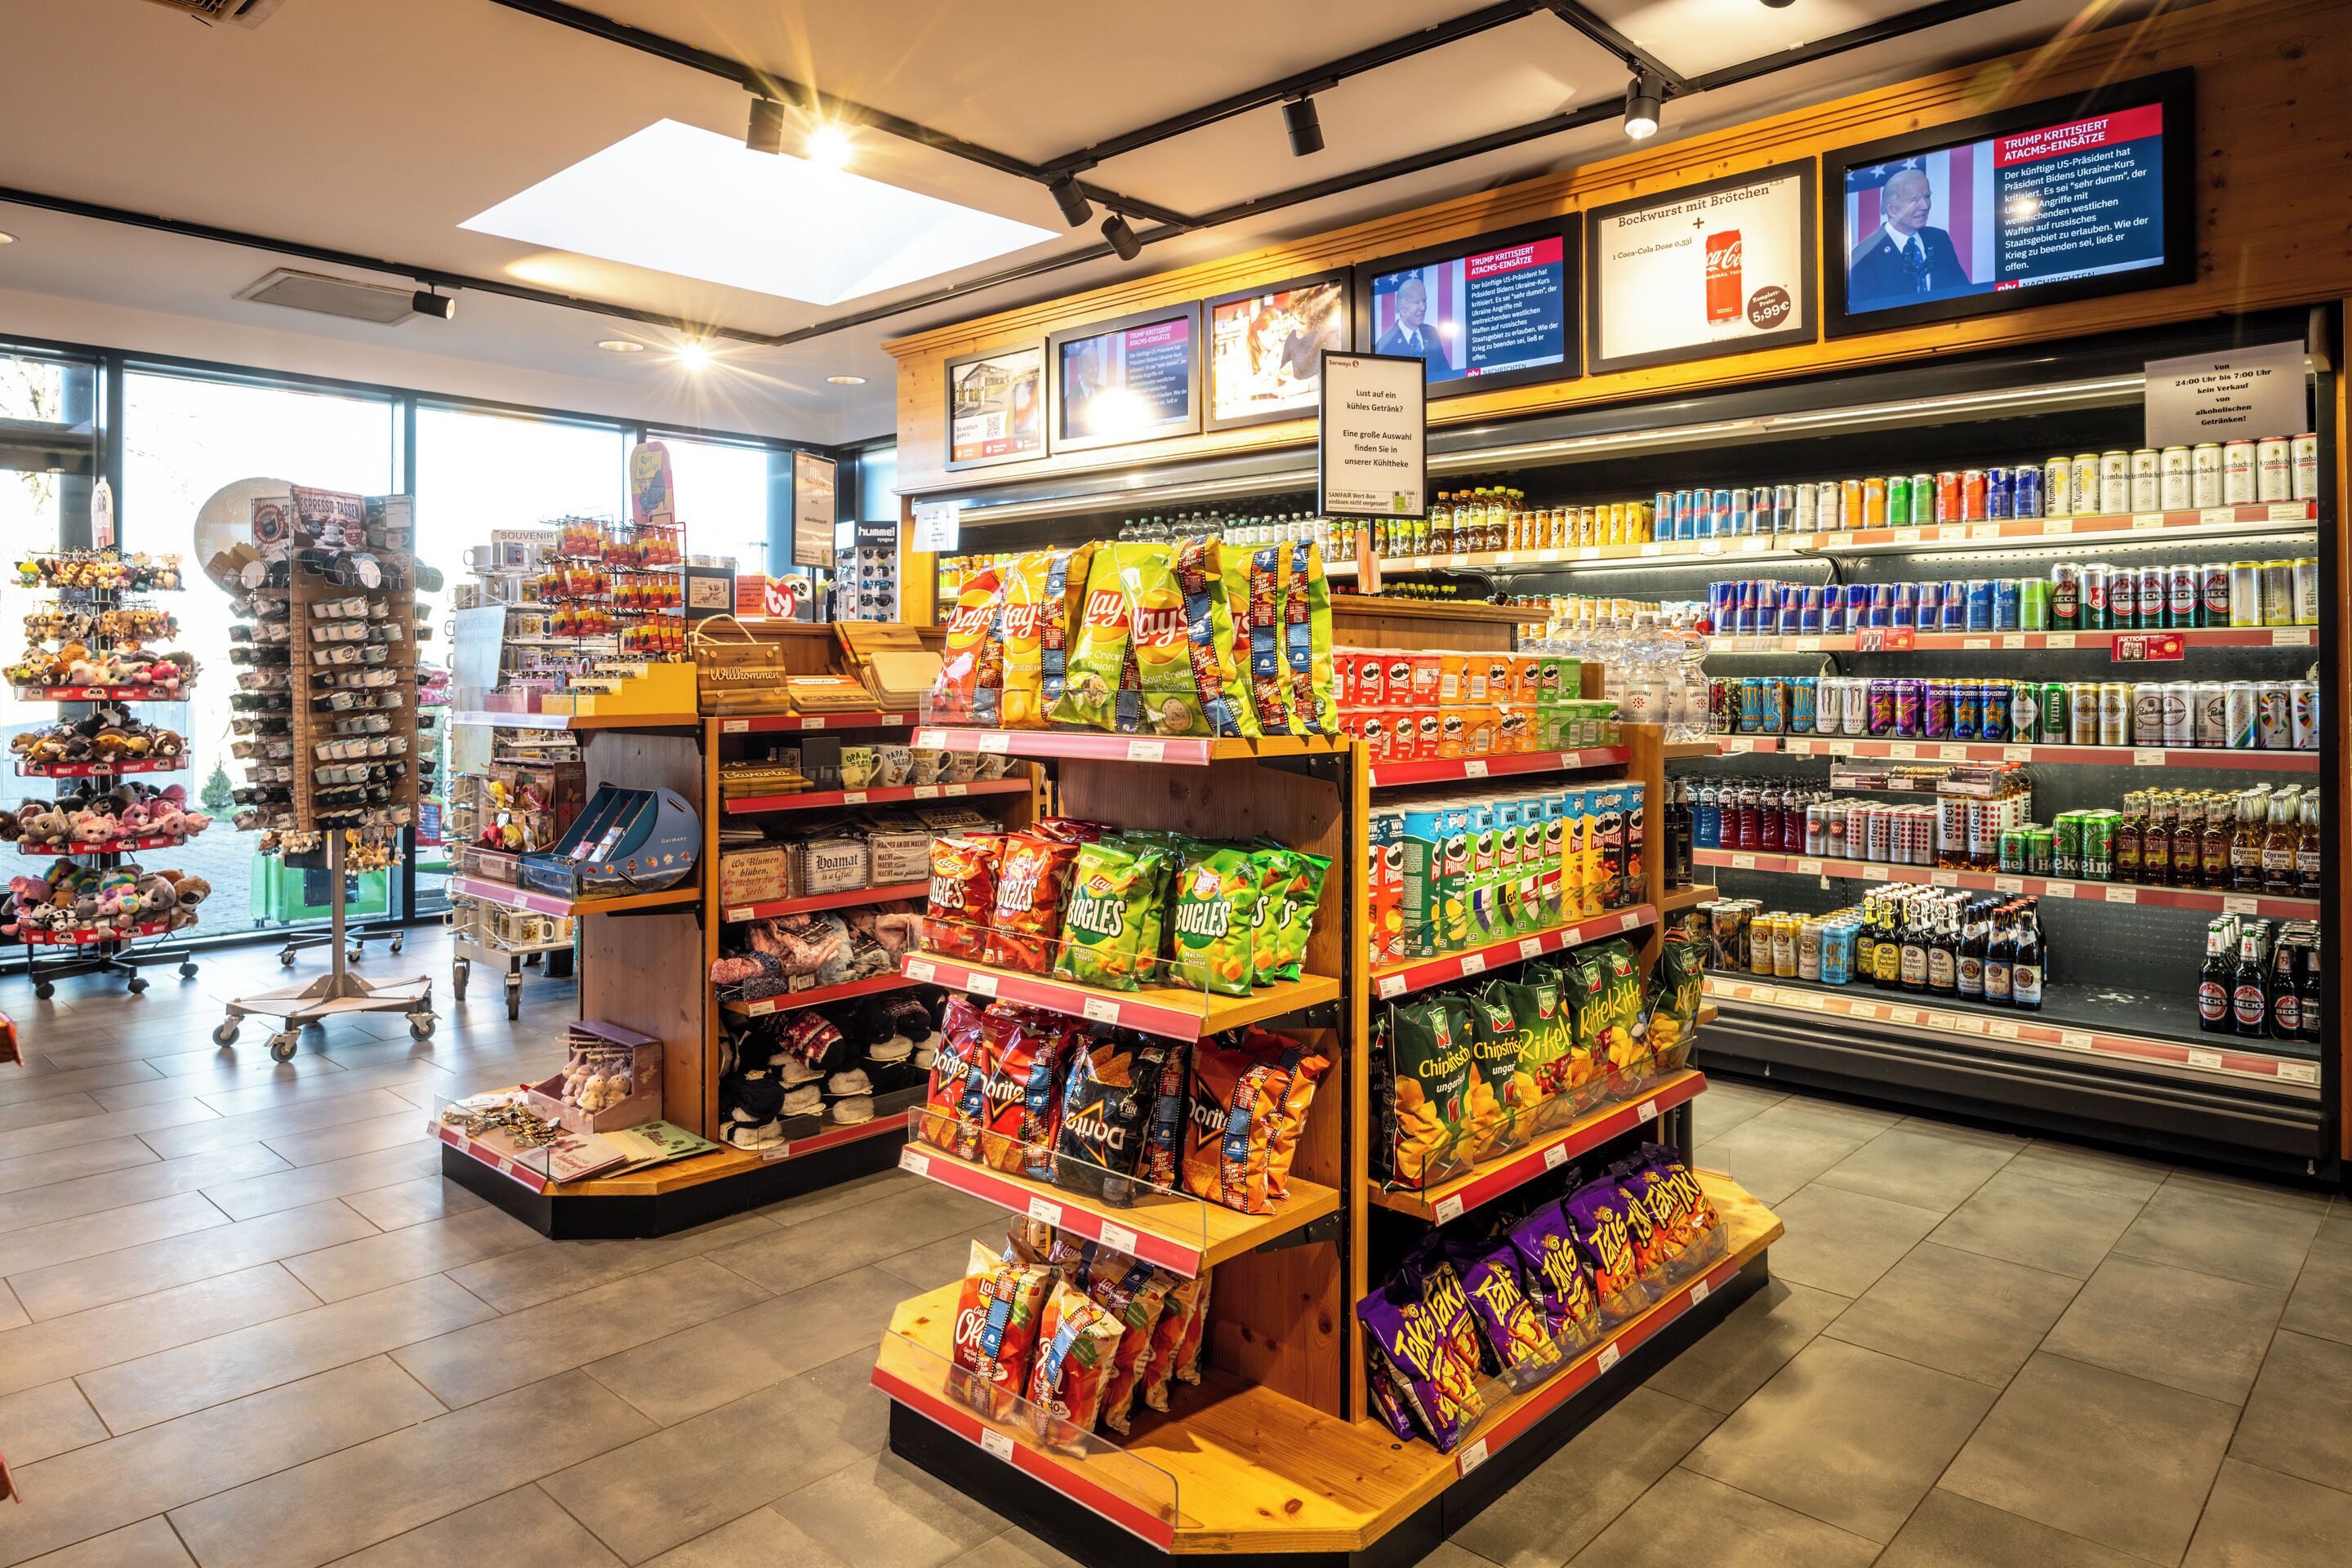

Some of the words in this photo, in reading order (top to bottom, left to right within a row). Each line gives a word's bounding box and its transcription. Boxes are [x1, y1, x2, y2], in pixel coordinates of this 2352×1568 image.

[2004, 134, 2041, 149] TRUMP
[2044, 119, 2109, 141] KRITISIERT
[2004, 131, 2105, 161] ATACMS-EINSÄTZE
[2005, 171, 2020, 180] Der
[2021, 163, 2056, 177] künftige
[2057, 153, 2114, 169] US-Präsident
[2116, 147, 2131, 157] hat
[2005, 179, 2044, 191] Präsident
[2046, 171, 2074, 183] Bidens
[2077, 159, 2135, 177] Ukraine-Kurs
[2005, 189, 2042, 203] kritisiert.
[2044, 187, 2054, 195] Es
[2056, 184, 2068, 193] sei
[2070, 180, 2093, 189] "sehr
[2095, 172, 2130, 185] dumm",
[2132, 168, 2147, 178] der
[2038, 194, 2072, 208] Angriffe
[2074, 191, 2088, 201] mit
[1618, 207, 1682, 228] Bockwurst
[1686, 199, 1707, 212] mit
[1710, 186, 1769, 206] Brötchen
[2005, 207, 2069, 225] weitreichenden
[2071, 198, 2118, 213] westlichen
[2005, 226, 2034, 237] Waffen
[2036, 223, 2050, 234] auf
[2051, 214, 2096, 229] russisches
[2005, 233, 2057, 248] Staatsgebiet
[2059, 231, 2069, 239] zu
[2070, 224, 2112, 237] erlauben.
[2114, 220, 2132, 229] Wie
[2133, 216, 2149, 226] der
[1618, 245, 1654, 260] Coca-Cola
[1655, 241, 1673, 252] Dose
[2005, 249, 2027, 260] Krieg
[2029, 247, 2038, 256] zu
[2040, 242, 2078, 254] beenden
[2079, 239, 2095, 249] sei,
[2096, 234, 2114, 245] ließ
[1471, 256, 1494, 266] TRUMP
[1495, 246, 1534, 261] KRITISIERT
[1471, 256, 1532, 275] ATACMS-EINSÄTZE
[2005, 261, 2029, 271] offen.
[1481, 278, 1503, 287] künftige
[1503, 271, 1538, 283] US-Präsident
[1472, 289, 1495, 299] Präsident
[1496, 285, 1514, 294] Bidens
[1515, 277, 1550, 290] Ukraine-Kurs
[1752, 289, 1780, 303] Komplett-
[1759, 297, 1776, 308] Preis:
[1472, 308, 1491, 317] Ukraine
[1492, 304, 1512, 313] Angriffe
[1472, 313, 1511, 326] weitreichenden
[1512, 307, 1540, 317] westlichen
[1753, 301, 1790, 323] 5,99€
[1472, 326, 1490, 334] Waffen
[1500, 318, 1527, 329] russisches
[1472, 332, 1503, 343] Staatsgebiet
[1537, 323, 1548, 332] Wie
[1129, 331, 1146, 339] TRUMP
[1493, 339, 1516, 348] beenden
[1527, 334, 1538, 342] ließ
[1329, 359, 1352, 368] Serways
[2175, 377, 2199, 386] 24:00
[2202, 375, 2217, 383] Uhr
[2234, 371, 2254, 379] 7:00
[2256, 368, 2272, 376] Uhr
[1356, 389, 1370, 398] Lust
[1385, 391, 1396, 399] ein
[2197, 386, 2215, 394] kein
[2216, 382, 2249, 392] Verkauf
[1347, 402, 1370, 411] kühles
[1371, 403, 1403, 413] Getränk?
[2195, 404, 2252, 416] alkoholischen
[2201, 416, 2246, 425] Getränken!
[1343, 430, 1358, 438] Eine
[1360, 431, 1380, 439] große
[1382, 432, 1412, 441] Auswahl
[1354, 444, 1377, 452] finden
[1373, 459, 1409, 468] Kühltheke
[2047, 467, 2056, 506] Krombacher
[301, 497, 359, 520] ESPRESSO-TASSEN
[858, 526, 895, 537] hummel
[765, 586, 792, 617] ty
[948, 603, 997, 636] Lay's
[1132, 603, 1188, 648] Lay's
[1088, 660, 1115, 671] Onion
[710, 668, 781, 681] Willkommen
[1142, 673, 1162, 684] Sour
[1163, 681, 1189, 692] Onion
[1360, 679, 1378, 690] PRINGLES
[1389, 679, 1410, 690] PRINGLES
[2051, 692, 2060, 724] VELTINS
[1420, 732, 1438, 742] PRINGLES
[846, 751, 861, 763] OPA
[886, 750, 904, 761] PAPA
[1945, 803, 1954, 840] effect
[661, 835, 687, 844] Germany
[2233, 847, 2259, 857] Corona
[732, 859, 745, 868] Wo
[746, 857, 779, 866] Blumen
[816, 854, 858, 871] Hoamat
[936, 858, 964, 871] Lay's
[740, 866, 768, 877] blühen,
[835, 868, 853, 881] Gfui!
[1196, 875, 1219, 892] Lay's
[742, 887, 766, 898] Seele!
[1067, 899, 1126, 937] BUGLES
[1175, 901, 1232, 938] BUGLES
[1074, 952, 1094, 963] Cheese
[1076, 947, 1093, 956] Nacho
[2198, 997, 2227, 1006] BECK'S
